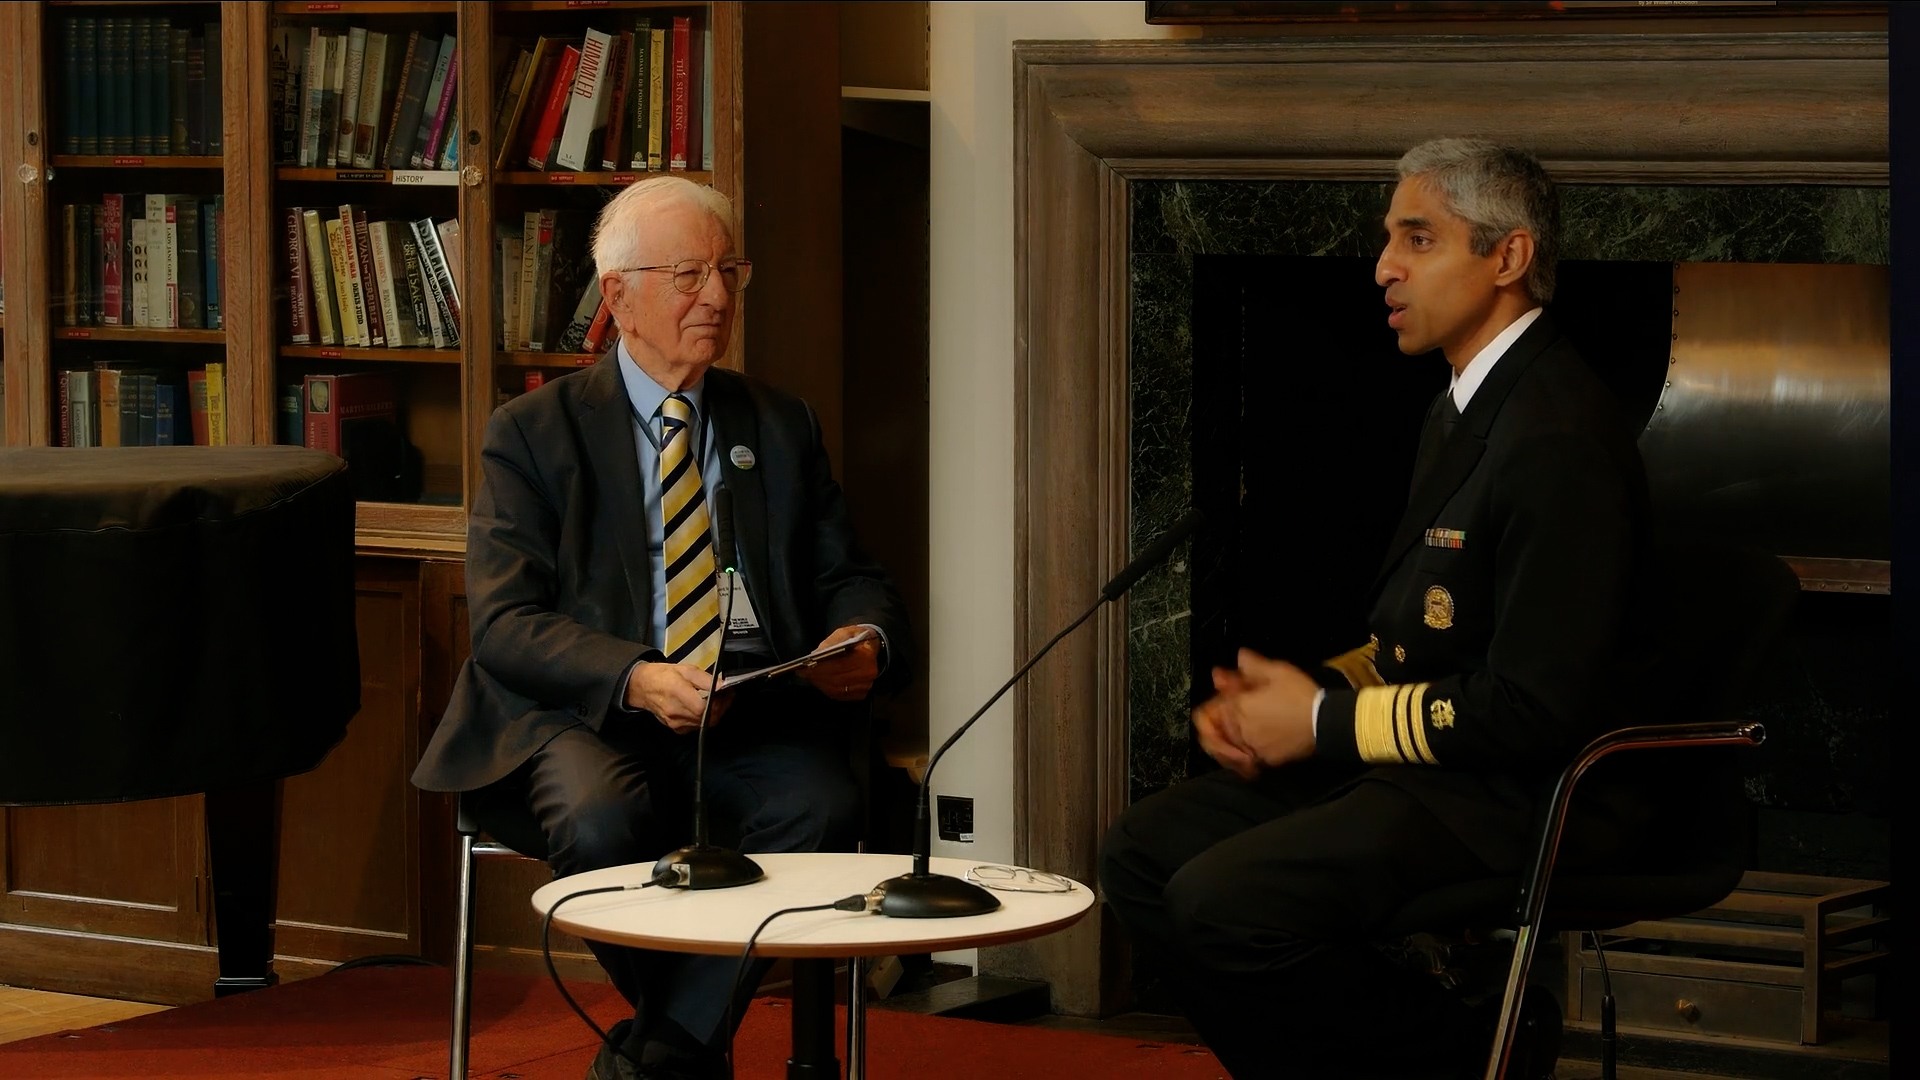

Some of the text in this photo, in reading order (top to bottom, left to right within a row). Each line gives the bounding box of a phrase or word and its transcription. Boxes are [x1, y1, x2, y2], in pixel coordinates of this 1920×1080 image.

[575, 38, 603, 99] HIMMLER
[613, 38, 628, 92] BISMARCK
[638, 78, 643, 86] DE
[675, 84, 684, 104] SUN
[675, 106, 684, 131] KING
[287, 214, 299, 279] GEORGE VI
[340, 210, 357, 278] THE CRIMEAN WAR
[403, 243, 410, 255] ON
[419, 224, 447, 281] STALIN
[523, 220, 535, 284] HANDEL
[311, 256, 327, 302] RUSSIA
[357, 235, 369, 263] IVAN
[363, 272, 377, 324] TERRIBLE
[407, 269, 423, 304] TSAR
[351, 282, 364, 325] DENIS JUDD
[59, 377, 68, 404] QUEEN
[209, 393, 220, 410] THE
[340, 401, 393, 414] MARTIN GILBERT
